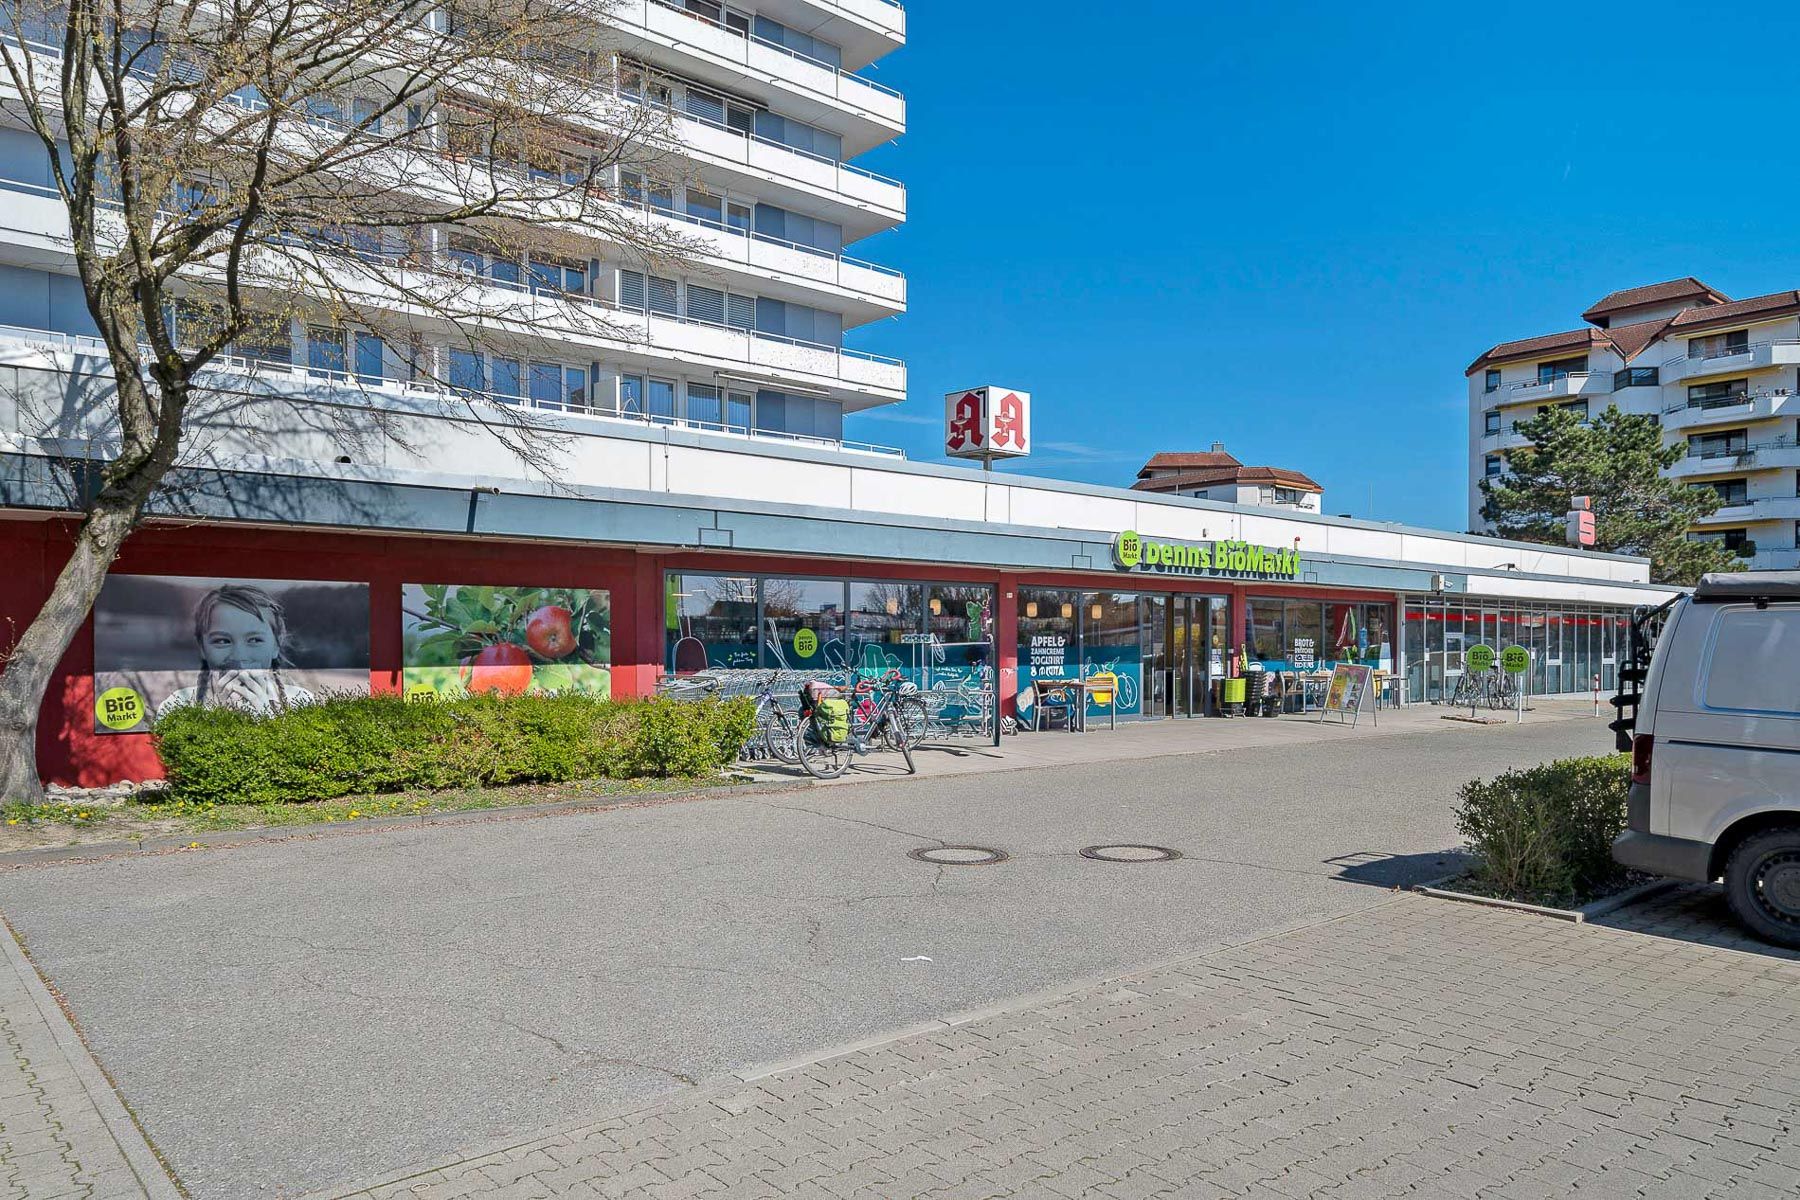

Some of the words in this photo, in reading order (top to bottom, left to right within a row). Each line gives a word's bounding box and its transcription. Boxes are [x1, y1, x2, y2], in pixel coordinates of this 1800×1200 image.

[1146, 541, 1211, 568] Denns
[798, 640, 813, 651] Bio
[1031, 636, 1057, 647] APFEL
[1472, 651, 1489, 661] Bio
[105, 695, 135, 713] Bio
[107, 712, 137, 722] Markt
